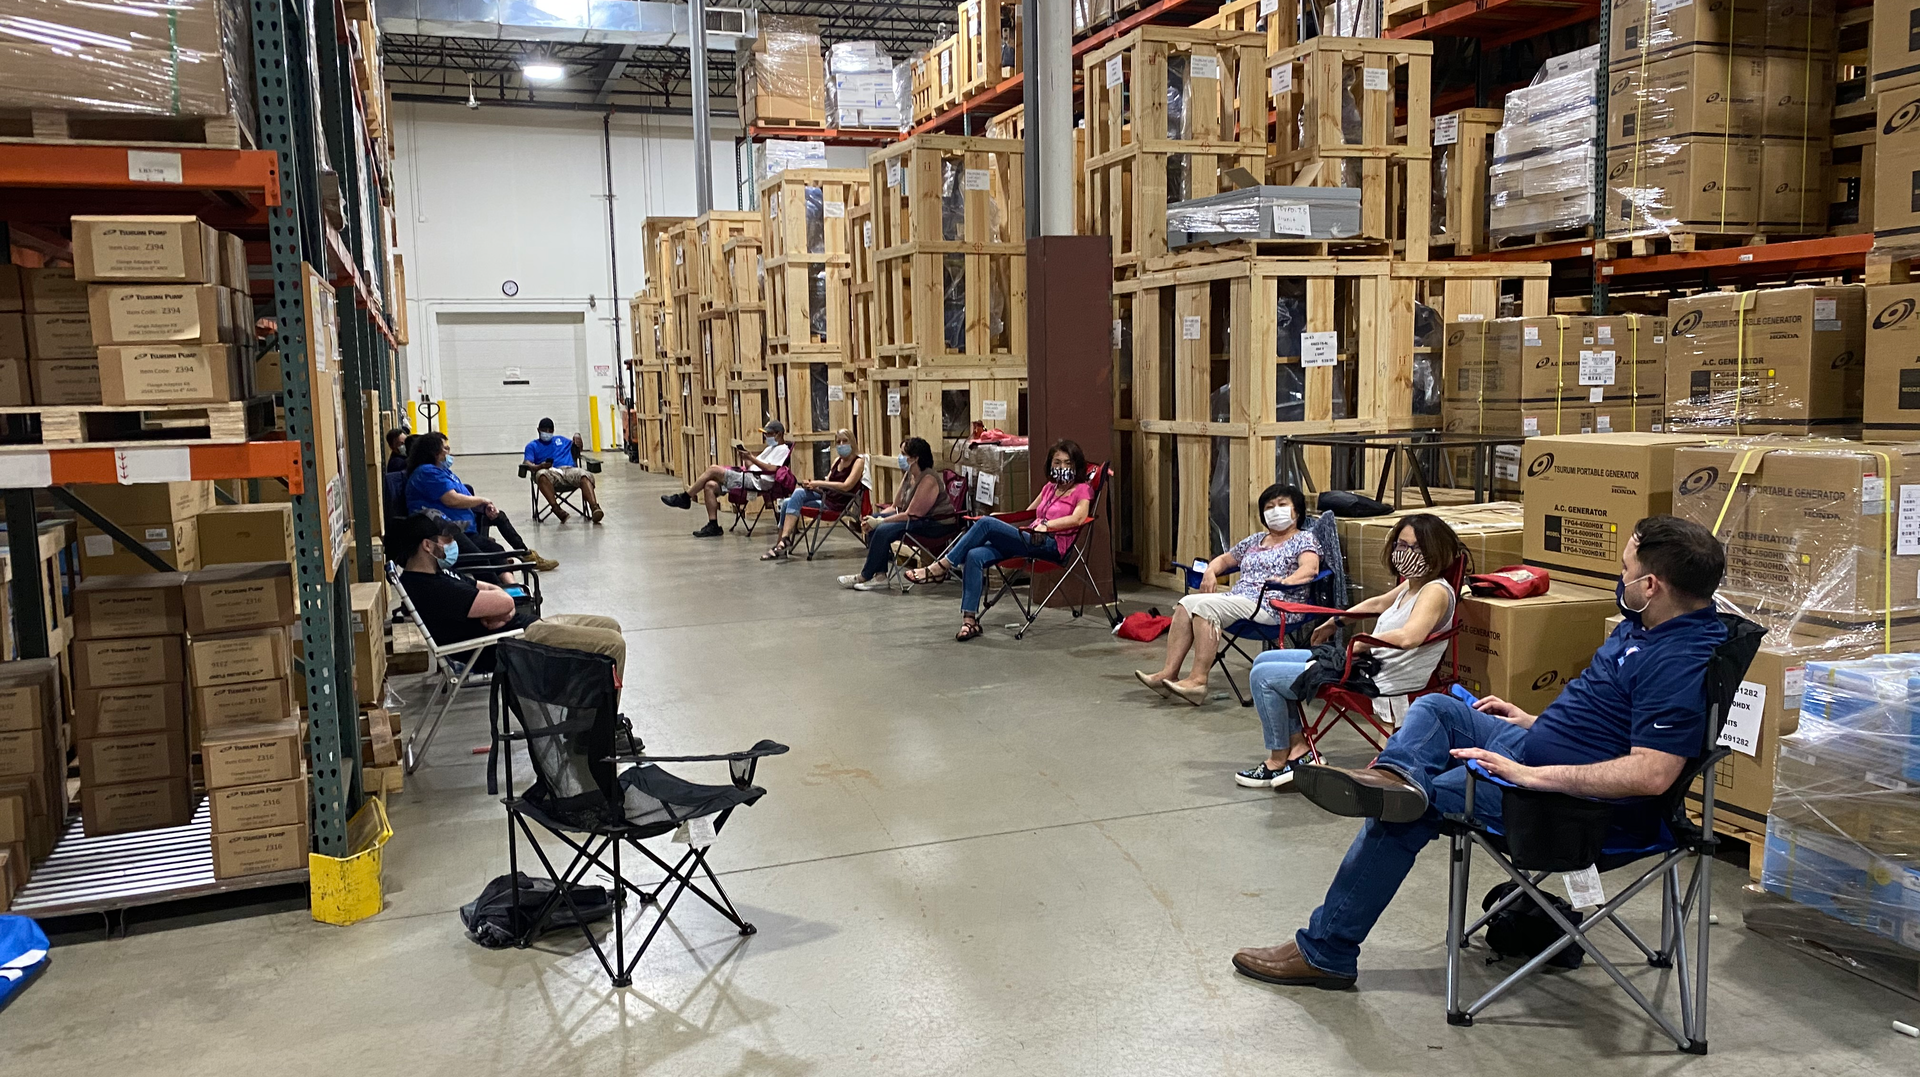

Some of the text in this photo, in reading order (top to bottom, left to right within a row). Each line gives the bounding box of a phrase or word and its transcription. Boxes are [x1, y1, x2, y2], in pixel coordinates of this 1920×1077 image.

[1702, 320, 1728, 329] TSURUMI
[1762, 315, 1802, 325] GENERATOR
[1702, 358, 1717, 366] A.C.
[1554, 465, 1639, 479] TSURUMI PORTABLE GENERATOR
[1611, 487, 1637, 495] HONDA
[1794, 488, 1846, 501] GENERATOR
[1554, 504, 1608, 517] A.C. GENERATOR
[1804, 511, 1840, 520] HONDA
[1564, 519, 1604, 530] TPG4-4500HDX
[1564, 528, 1604, 539] TPG4-6000HDX
[1738, 531, 1797, 546] GENERATOR
[1564, 537, 1604, 549] TPG4-7000HDX
[1564, 546, 1606, 558] TPG4-7000HDXE
[1469, 626, 1501, 641] GENERATOR
[1475, 646, 1499, 656] HONDA
[1723, 733, 1750, 747] 691282
